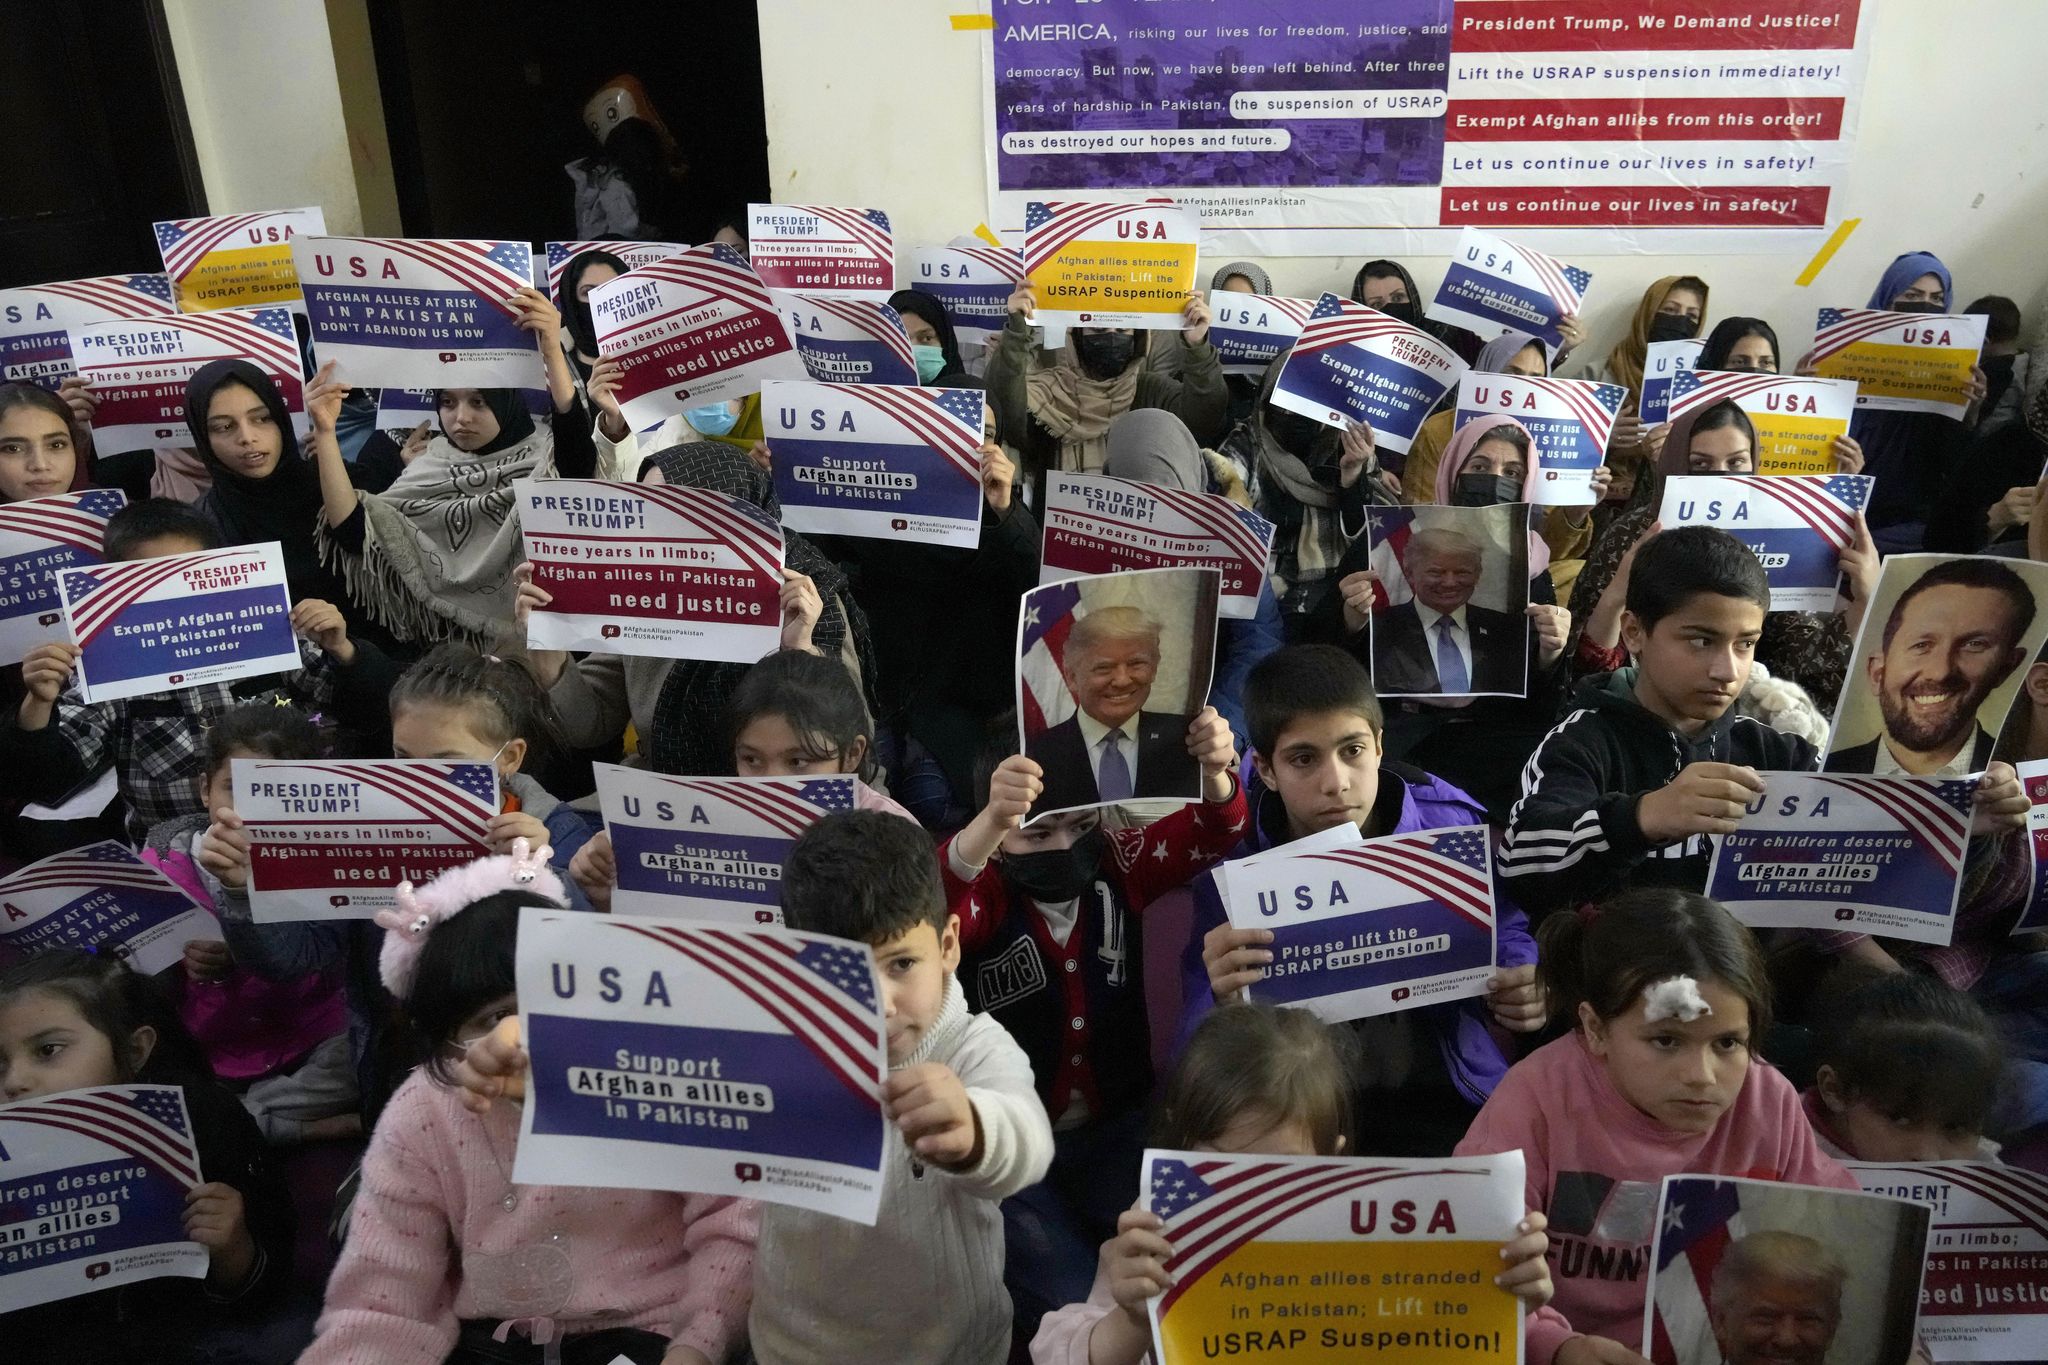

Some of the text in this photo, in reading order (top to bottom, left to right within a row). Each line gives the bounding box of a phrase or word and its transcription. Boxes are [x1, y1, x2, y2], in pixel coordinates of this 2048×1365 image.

[1462, 13, 1840, 32] President Trump, We Demand Justice!
[1004, 23, 1118, 43] AMERICA,
[1129, 27, 1176, 41] risking
[1185, 27, 1207, 38] our
[1216, 26, 1249, 38] lives
[1258, 25, 1277, 37] for
[1358, 23, 1412, 38] justice,
[1422, 23, 1447, 35] and
[1006, 60, 1445, 80] democracy. But now, we have been left behind. After three
[1458, 65, 1840, 80] Lift the USRAP suspension immediately!
[1008, 102, 1044, 116] years
[1053, 101, 1066, 113] of
[1073, 99, 1132, 114] hardship
[1141, 100, 1153, 111] in
[1234, 98, 1258, 111] the
[1267, 97, 1353, 112] suspension
[1364, 96, 1378, 109] of
[1387, 95, 1444, 109] USRAP
[1457, 112, 1821, 129] Exempt Afghan allies from this order!
[1010, 133, 1276, 150] has destroyed our hopes and future.
[1453, 155, 1814, 171] Let us continue our lives in safety!
[756, 216, 820, 226] PRESIDENT
[775, 225, 819, 235] TRUMP!
[1117, 220, 1167, 239] USA
[315, 255, 400, 279] USA
[1057, 256, 1179, 268] Afghan allies stranded
[1467, 246, 1513, 275] USA
[797, 273, 883, 286] need justice
[316, 292, 478, 308] AFGHAN ALLIES AT RISK
[596, 281, 660, 316] PRESIDENT
[329, 306, 474, 324] IN PAKISTAN
[613, 296, 664, 323] TRUMP!
[320, 322, 484, 338] DON'T ABANDON US NOW
[1903, 328, 1952, 346] USA
[666, 334, 776, 378] need justice
[1320, 353, 1432, 404] Exempt Afghan allies
[780, 407, 856, 432] USA
[822, 456, 886, 472] Support
[799, 468, 913, 487] Afghan allies
[816, 484, 902, 500] in Pakistan
[1059, 484, 1158, 509] PRESIDENT
[531, 496, 645, 513] PRESIDENT
[1087, 499, 1154, 523] TRUMP!
[1678, 501, 1749, 521] USA
[566, 513, 645, 529] TRUMP!
[532, 542, 715, 562] Three years in limbo;
[183, 562, 267, 581] PRESIDENT
[539, 566, 756, 587] Afghan allies in Pakistan
[189, 574, 249, 592] TRUMP!
[610, 593, 762, 615] need justice
[114, 604, 284, 637] Exempt Afghan allies
[141, 622, 264, 648] in Pakistan from
[175, 640, 240, 658] this order
[251, 783, 361, 797] PRESIDENT
[282, 799, 360, 813] TRUMP!
[623, 795, 710, 825] USA
[1726, 835, 1913, 849] Our children deserve
[1743, 865, 1871, 880] Afghan allies
[1258, 880, 1350, 916] USA
[1282, 928, 1418, 960] Please lift the
[1330, 937, 1444, 967] suspension!
[552, 963, 672, 1008] USA
[615, 1049, 721, 1079] Support
[578, 1071, 766, 1107] Afghan allies
[606, 1099, 750, 1131] in Pakistan
[57, 1165, 147, 1191] deserve
[1350, 1200, 1457, 1235] USA
[1960, 1234, 2019, 1246] limbo;
[1220, 1270, 1481, 1290] Afghan allies stranded
[1232, 1297, 1469, 1319] in Pakistan; Lift the
[1203, 1329, 1500, 1358] USRAP Suspention!
